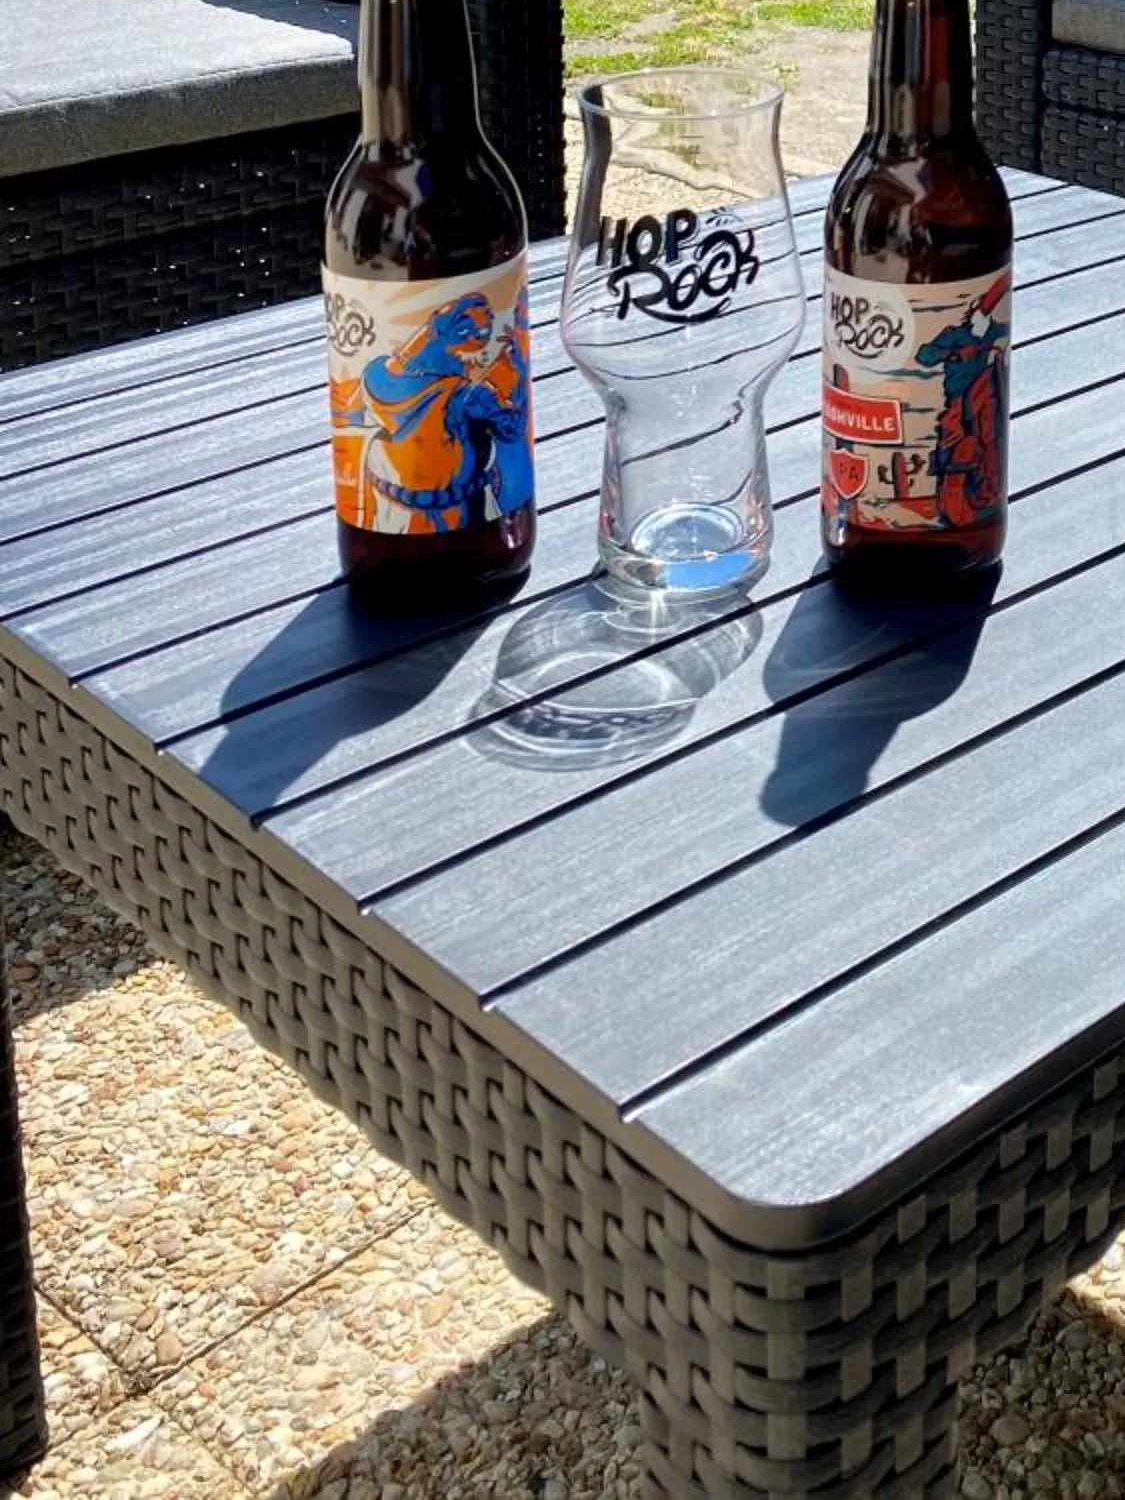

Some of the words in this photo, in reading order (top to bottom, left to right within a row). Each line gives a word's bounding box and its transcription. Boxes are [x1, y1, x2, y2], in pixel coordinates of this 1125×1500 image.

[597, 208, 698, 266] HOP
[607, 230, 759, 324] ROCK
[831, 291, 869, 324] HOP
[835, 314, 904, 358] ROCK
